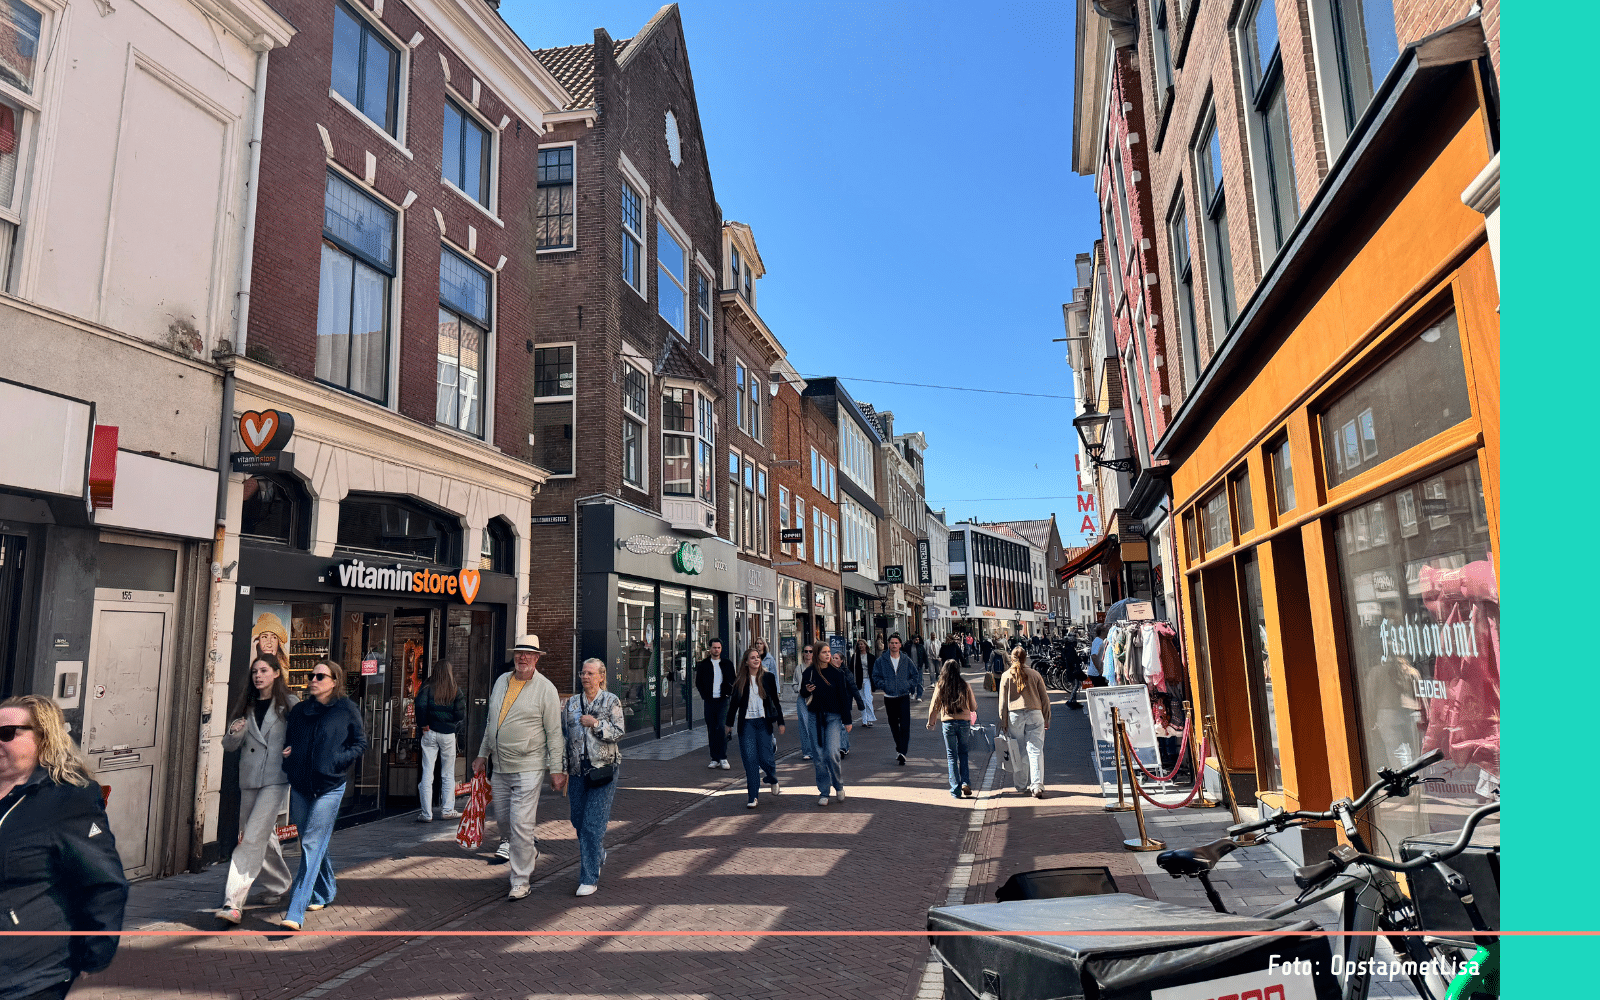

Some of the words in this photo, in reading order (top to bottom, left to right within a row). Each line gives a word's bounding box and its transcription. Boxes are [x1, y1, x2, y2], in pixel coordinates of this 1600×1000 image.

[237, 455, 276, 463] vitaminstore
[338, 558, 457, 596] vitaminstore
[122, 591, 132, 600] 155
[1379, 611, 1479, 666] Fashionomi
[1412, 680, 1447, 699] LEIDEN
